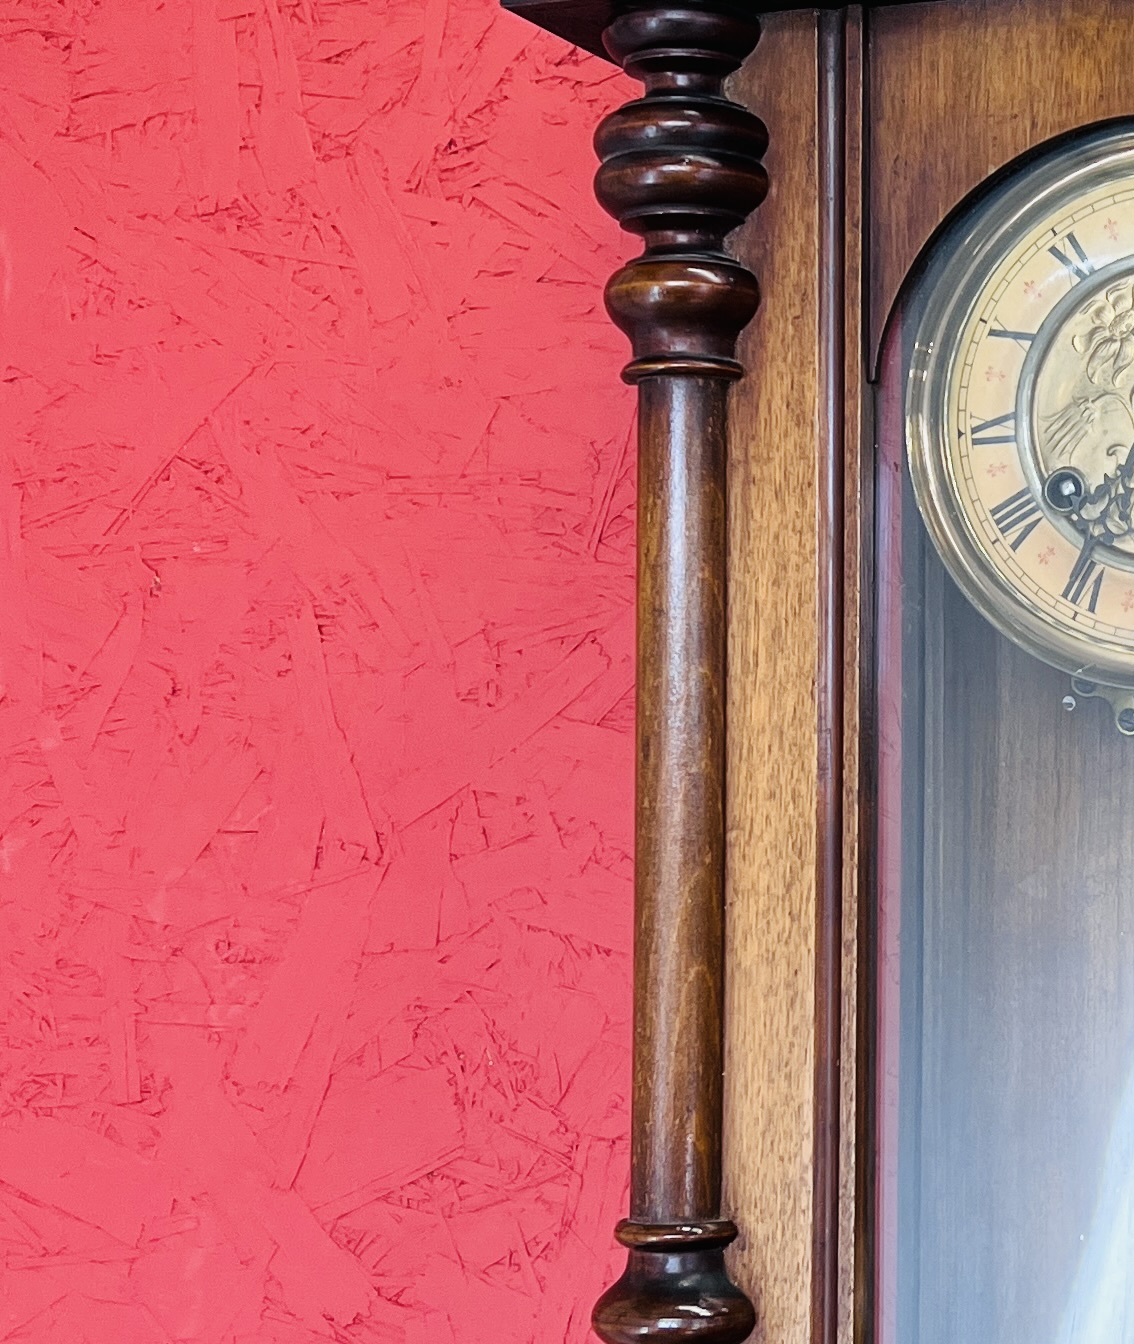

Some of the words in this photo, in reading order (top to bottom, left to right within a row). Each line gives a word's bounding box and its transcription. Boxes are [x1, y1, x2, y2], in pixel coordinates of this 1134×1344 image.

[1048, 231, 1096, 288] XI
[986, 316, 1038, 354] X
[969, 411, 1017, 449] IX
[989, 486, 1045, 554] VIII
